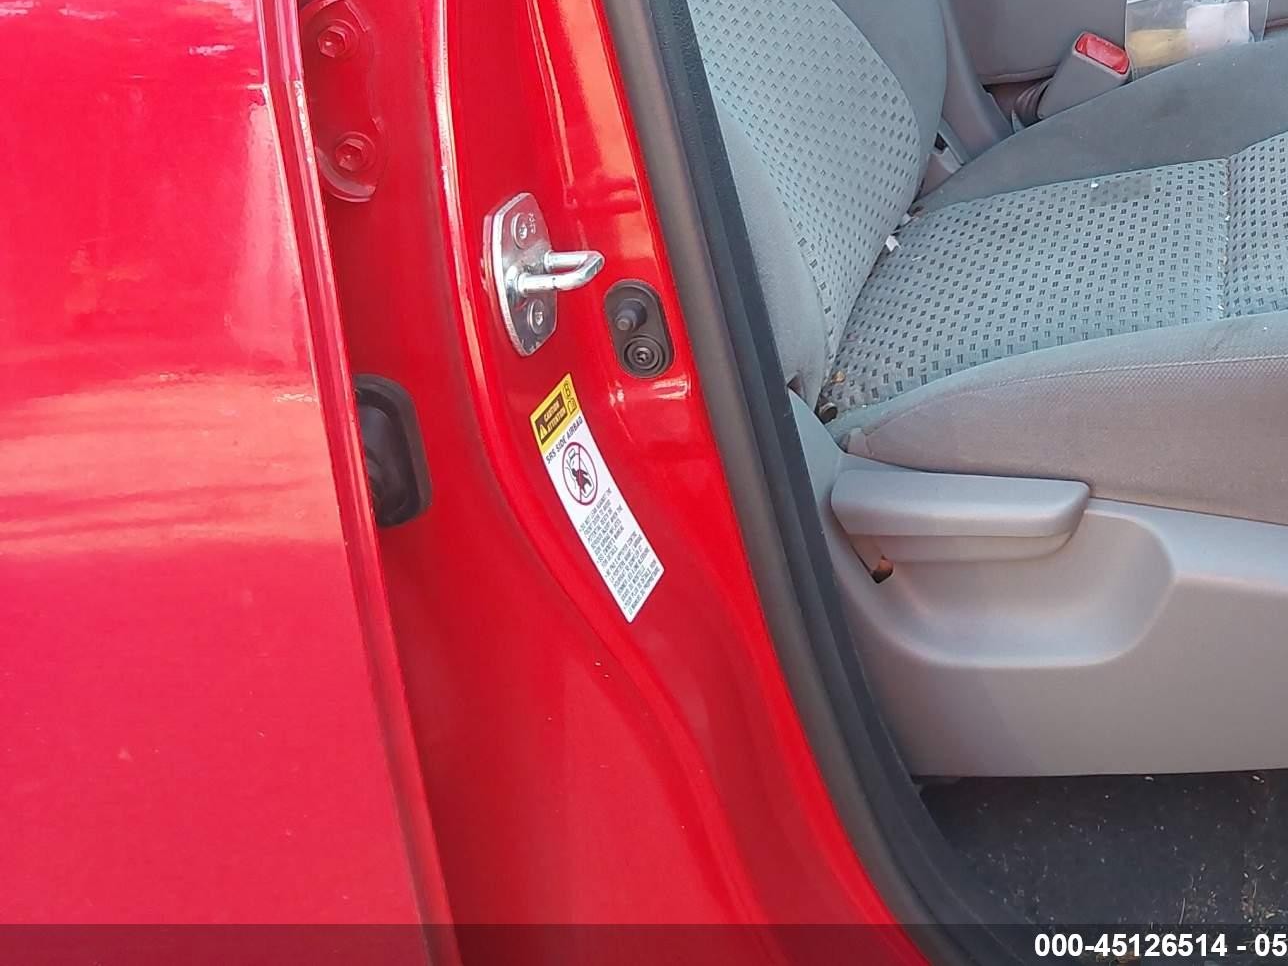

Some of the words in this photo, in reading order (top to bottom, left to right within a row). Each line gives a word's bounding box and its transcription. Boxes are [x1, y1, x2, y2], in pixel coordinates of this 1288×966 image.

[546, 448, 557, 464] SRS
[555, 434, 567, 452] SIDE
[566, 416, 584, 440] AIRBAG
